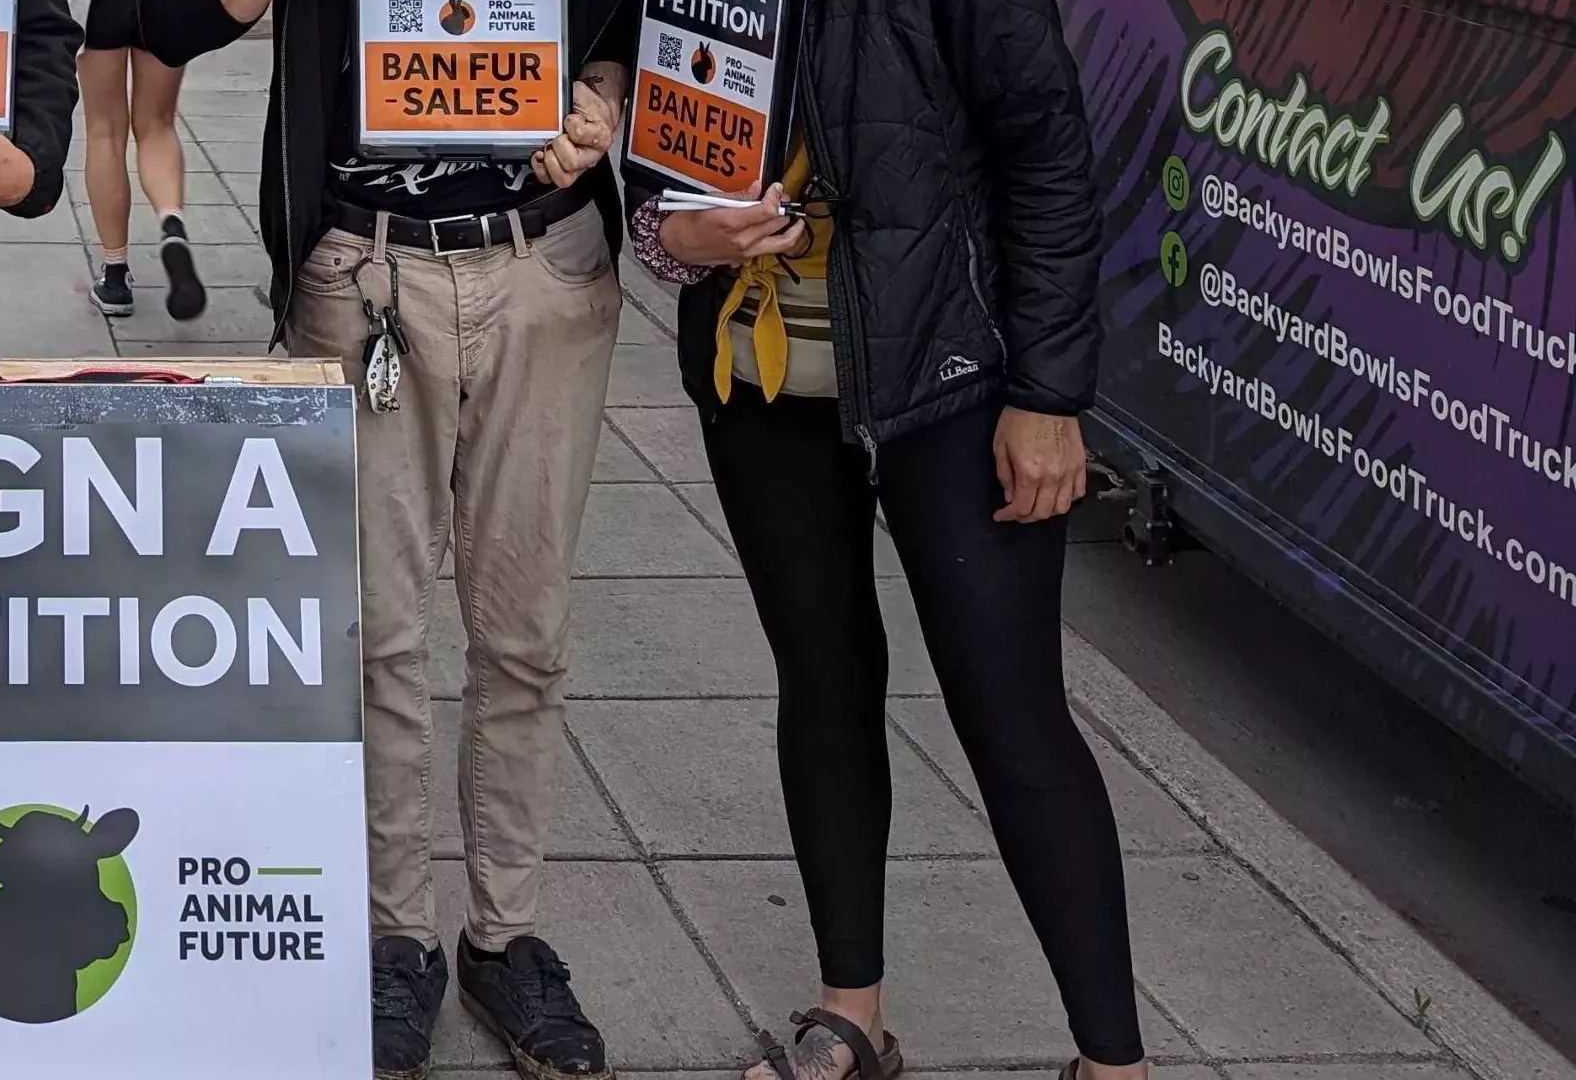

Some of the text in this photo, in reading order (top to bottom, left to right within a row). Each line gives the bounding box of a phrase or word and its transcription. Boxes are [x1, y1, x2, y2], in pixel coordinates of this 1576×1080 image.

[488, 0, 512, 10] PRO
[488, 11, 535, 20] ANIMAL
[488, 21, 535, 31] FUTURE
[382, 53, 542, 80] BAN FUR
[725, 56, 742, 69] PRO
[723, 78, 755, 98] FUTURE
[724, 68, 756, 86] ANIMAL
[648, 83, 753, 150] BAN FUR
[1181, 29, 1566, 262] Contact Us!
[1157, 322, 1576, 608] BackyardBowlsFoodTruck.com
[205, 438, 319, 556] A
[179, 857, 250, 886] PRO
[180, 894, 324, 923] ANIMAL
[180, 931, 324, 961] FUTURE
